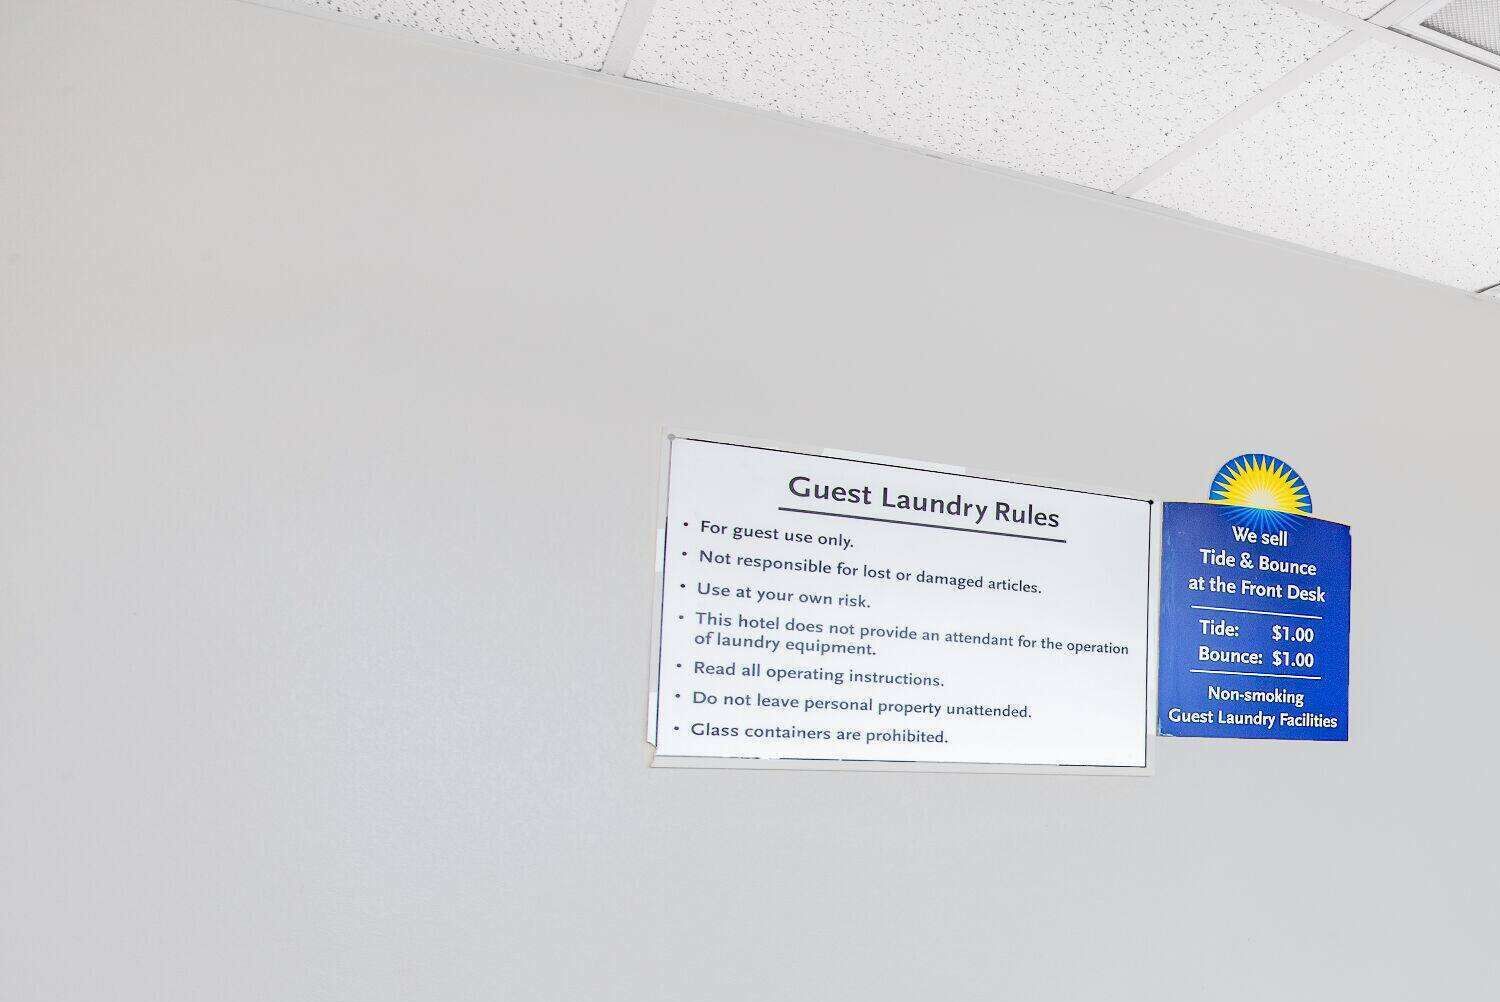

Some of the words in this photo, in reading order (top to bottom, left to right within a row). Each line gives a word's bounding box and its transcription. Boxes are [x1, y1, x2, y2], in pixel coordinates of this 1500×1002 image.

[788, 476, 872, 505] Guest
[882, 487, 988, 524] Laundry
[996, 501, 1060, 528] Rules
[701, 521, 727, 535] For
[732, 525, 778, 541] guest
[785, 529, 813, 542] use
[818, 531, 854, 550] only.
[1232, 526, 1257, 543] We
[1262, 531, 1288, 546] sell
[699, 550, 731, 565] Not
[737, 551, 832, 574] responsible
[837, 562, 859, 577] for
[864, 563, 891, 579] lost
[896, 568, 911, 580] or
[916, 570, 983, 589] damaged
[988, 576, 1042, 594] articles.
[1200, 549, 1236, 567] Tide
[1240, 552, 1253, 569] &
[1259, 556, 1317, 576] Bounce
[697, 583, 730, 597] Use
[736, 586, 751, 599] at
[756, 589, 793, 604] your
[799, 592, 832, 604] own
[838, 592, 871, 608] risk.
[1189, 577, 1204, 590] at
[1209, 578, 1236, 594] the
[1241, 580, 1282, 598] Front
[1288, 585, 1326, 602] Desk
[696, 612, 731, 627] This
[738, 614, 779, 630] hotel
[785, 616, 823, 633] does
[829, 622, 855, 635] not
[860, 623, 917, 643] provide
[922, 628, 939, 641] an
[945, 628, 1014, 647] attendant
[1018, 634, 1037, 648] for
[1040, 636, 1063, 650] the
[1067, 638, 1129, 657] operation
[1200, 620, 1239, 636] Tide:
[1272, 625, 1314, 643] $1.00
[695, 631, 715, 646] of
[717, 632, 780, 653] laundry
[786, 638, 876, 658] equipment.
[1198, 647, 1262, 664] Bounce:
[1272, 650, 1314, 668] $1.00
[694, 662, 735, 676] Read
[741, 664, 761, 677] all
[766, 665, 844, 684] operating
[849, 669, 944, 686] instructions.
[693, 691, 718, 705] Do
[724, 694, 751, 707] not
[757, 693, 799, 709] leave
[805, 695, 872, 714] personal
[878, 699, 941, 717] property
[947, 703, 1031, 719] unattended.
[1208, 686, 1304, 706] Non-smoking
[1169, 709, 1213, 724] Guest
[1218, 711, 1275, 729] Laundry
[1280, 713, 1338, 728] Facilities
[691, 722, 739, 738] Glass
[744, 723, 831, 740] containers
[837, 729, 861, 740] are
[866, 726, 948, 744] prohibited.
